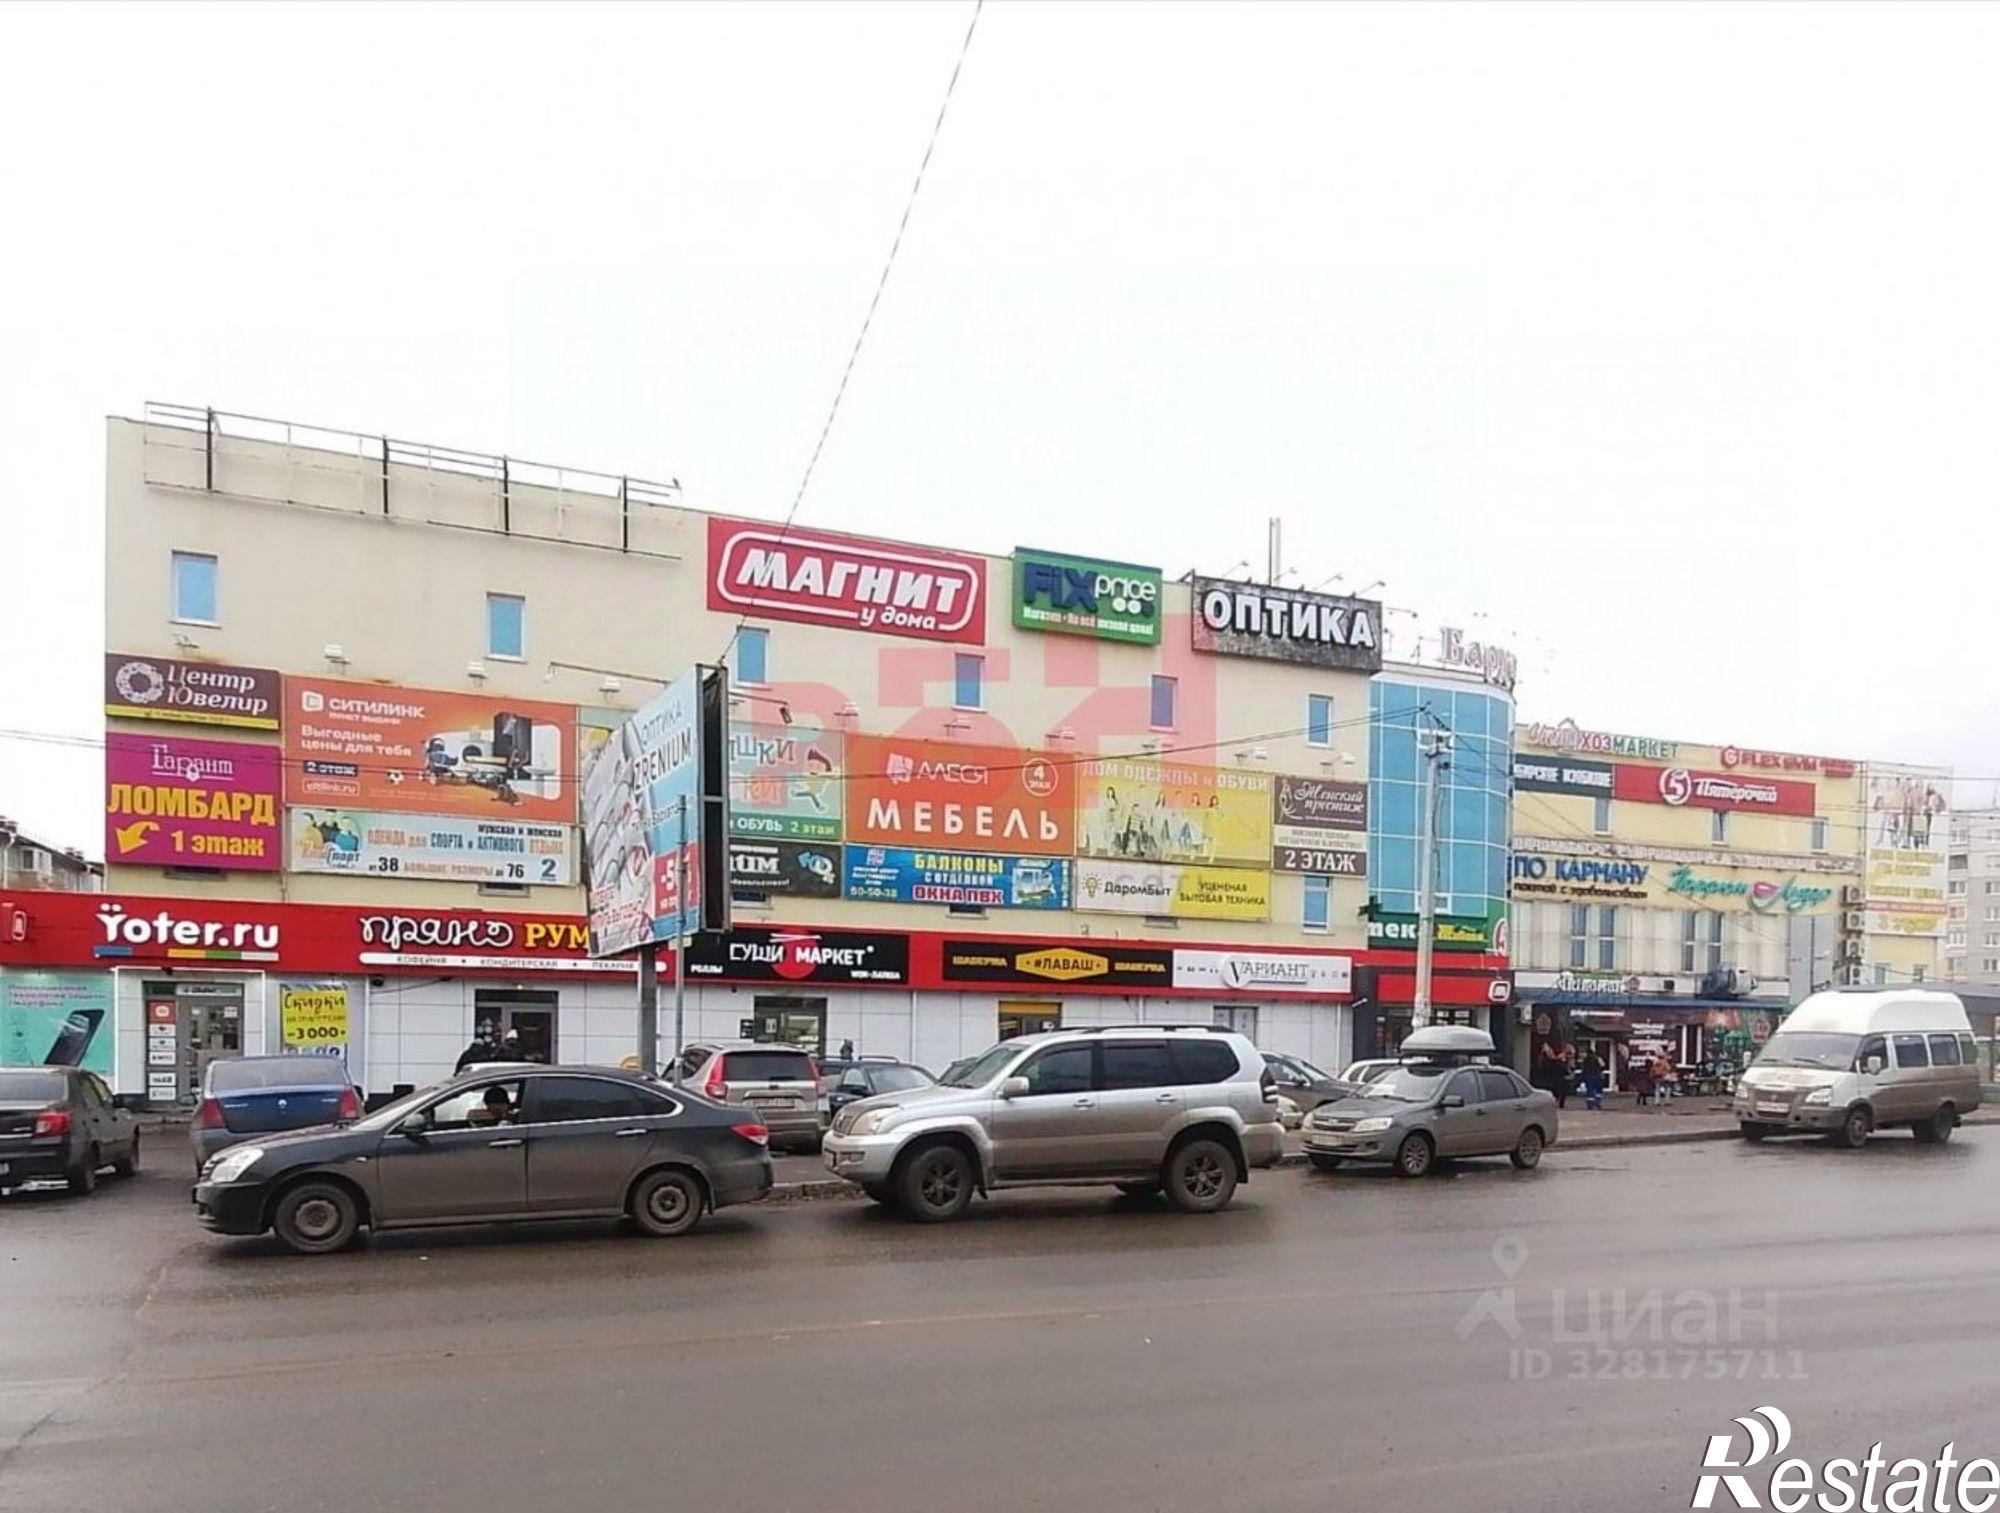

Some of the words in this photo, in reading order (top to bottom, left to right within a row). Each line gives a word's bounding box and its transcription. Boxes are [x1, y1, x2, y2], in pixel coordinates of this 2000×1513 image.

[735, 547, 964, 611] МАГНИТ
[1022, 562, 1098, 612] FIX
[1094, 574, 1157, 601] price
[859, 606, 874, 628] у
[883, 607, 936, 631] дома
[1203, 590, 1376, 649] ОПТИКА
[166, 664, 256, 693] Центр
[166, 687, 269, 715] Ювелир
[329, 699, 426, 718] СИТИЛИНК
[300, 724, 383, 742] Выгодные
[344, 743, 374, 755] для
[377, 744, 413, 757] тебя
[1581, 733, 1679, 758] ХОЗМАРКЕТ
[150, 744, 234, 776] Гарант
[1034, 766, 1045, 779] 4
[1082, 761, 1118, 777] ДОМ
[1123, 764, 1200, 785] ОДЕЖДЫ
[1217, 775, 1268, 792] ОБУВИ
[108, 784, 276, 827] ЛОМБАРД
[737, 817, 783, 833] ОБУВЬ
[790, 822, 800, 834] 2
[803, 824, 835, 835] этаж
[866, 797, 1059, 841] МЕБЕЛЬ
[171, 830, 184, 852] 1
[191, 834, 265, 857] этаж
[431, 832, 464, 849] СПОРТА
[378, 856, 399, 872] 38
[507, 862, 525, 878] 76
[542, 858, 557, 878] 2
[914, 854, 1004, 874] БАЛКОНЫ
[1285, 850, 1296, 868] 2
[1301, 851, 1355, 872] ЭТАЖ
[1515, 857, 1547, 879] ПО
[1555, 859, 1649, 885] КАРМАНУ
[914, 887, 962, 903] ОКНА
[966, 889, 1002, 905] ПВХ
[1104, 882, 1172, 898] ДаромБыт
[729, 944, 782, 963] СУШИ
[796, 948, 865, 965] МАРКЕТ
[1033, 957, 1094, 971] #ЛАВАШ
